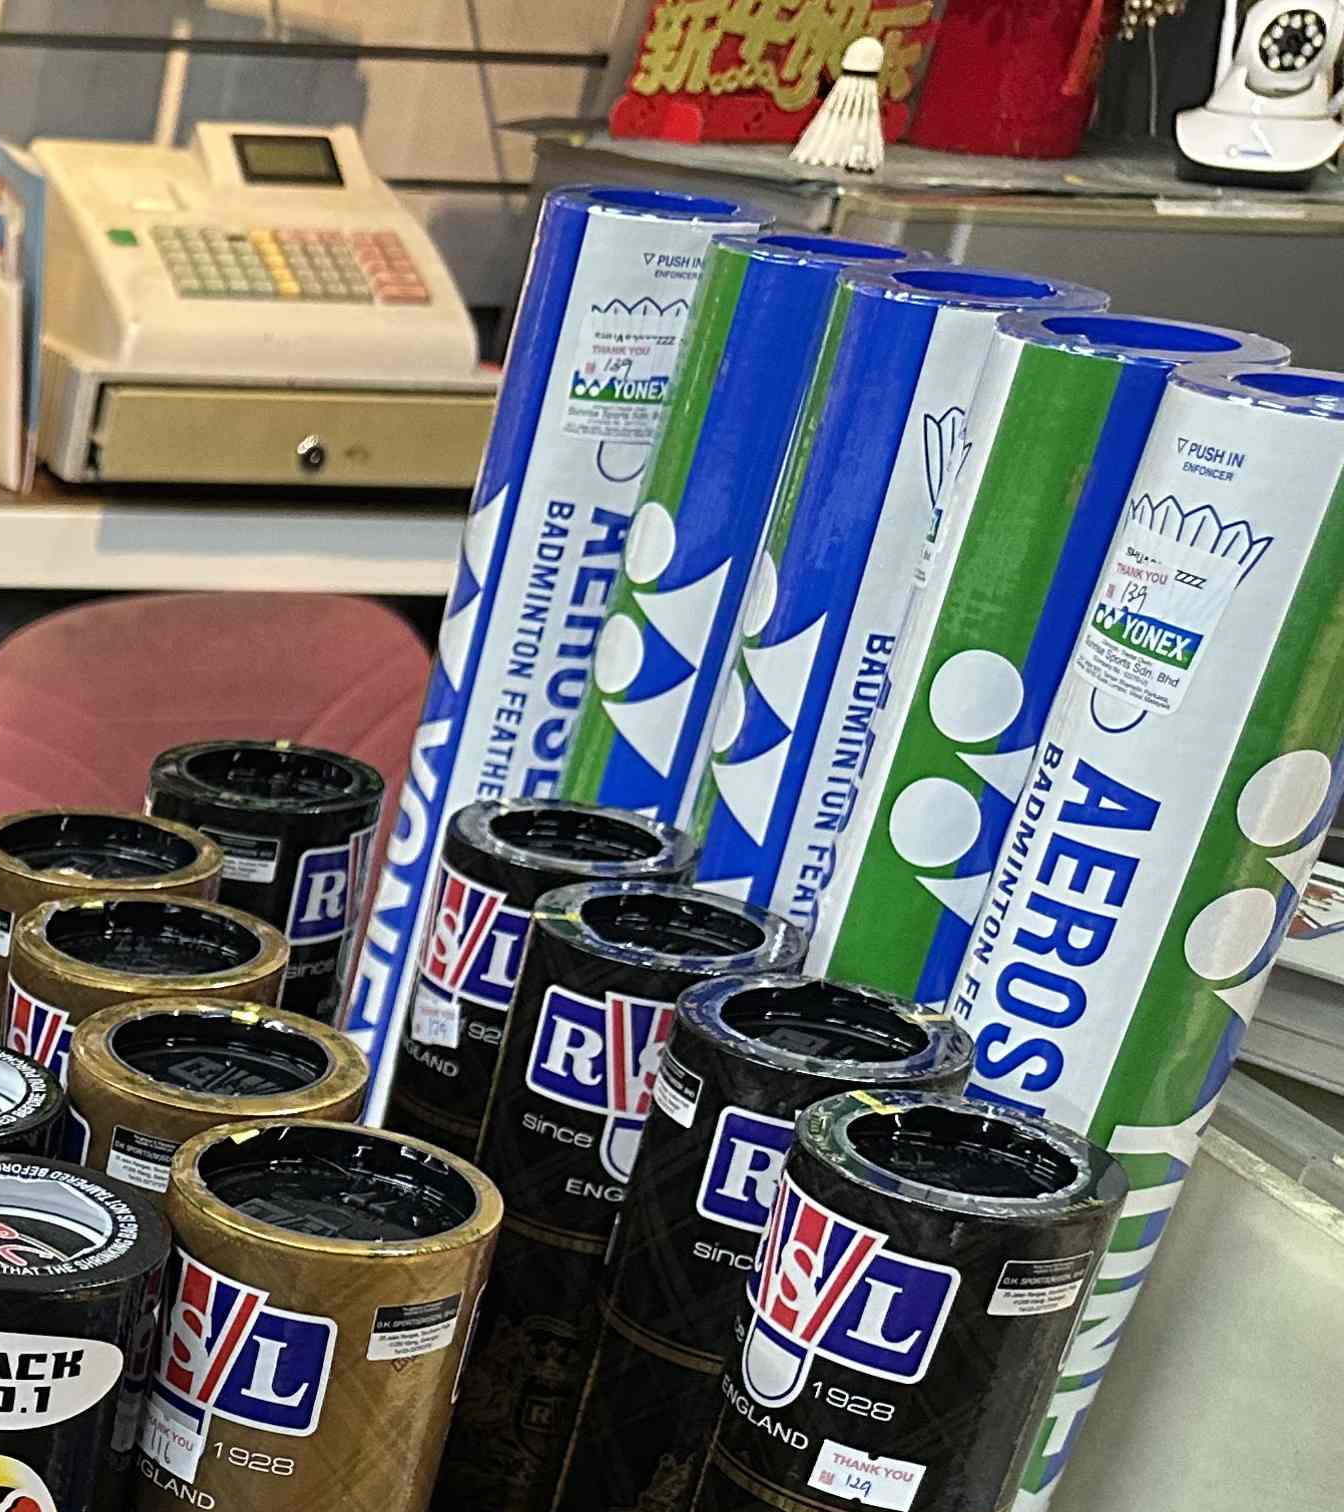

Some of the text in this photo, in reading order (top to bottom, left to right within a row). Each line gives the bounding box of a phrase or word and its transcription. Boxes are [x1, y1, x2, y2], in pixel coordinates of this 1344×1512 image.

[657, 254, 690, 268] PUSH
[613, 379, 669, 400] YONEX
[1187, 441, 1246, 469] PUSH IN
[1116, 561, 1170, 587] THANK YOU
[474, 499, 575, 802] BADMINTON FEATHE
[1121, 614, 1193, 663] YONEX
[975, 741, 1064, 967] BADMINTON
[962, 754, 1163, 1118] AEROS
[521, 1111, 594, 1151] since
[49, 1166, 116, 1202] TAMPERED
[1, 1264, 40, 1278] THAT
[44, 1259, 78, 1277] THE
[693, 1240, 755, 1272] sinc
[720, 1373, 810, 1453] ENGLAND
[811, 1378, 896, 1424] 1928
[211, 1440, 296, 1478] 1928
[831, 1451, 916, 1484] THANK YOU
[138, 1459, 216, 1512] GLAND
